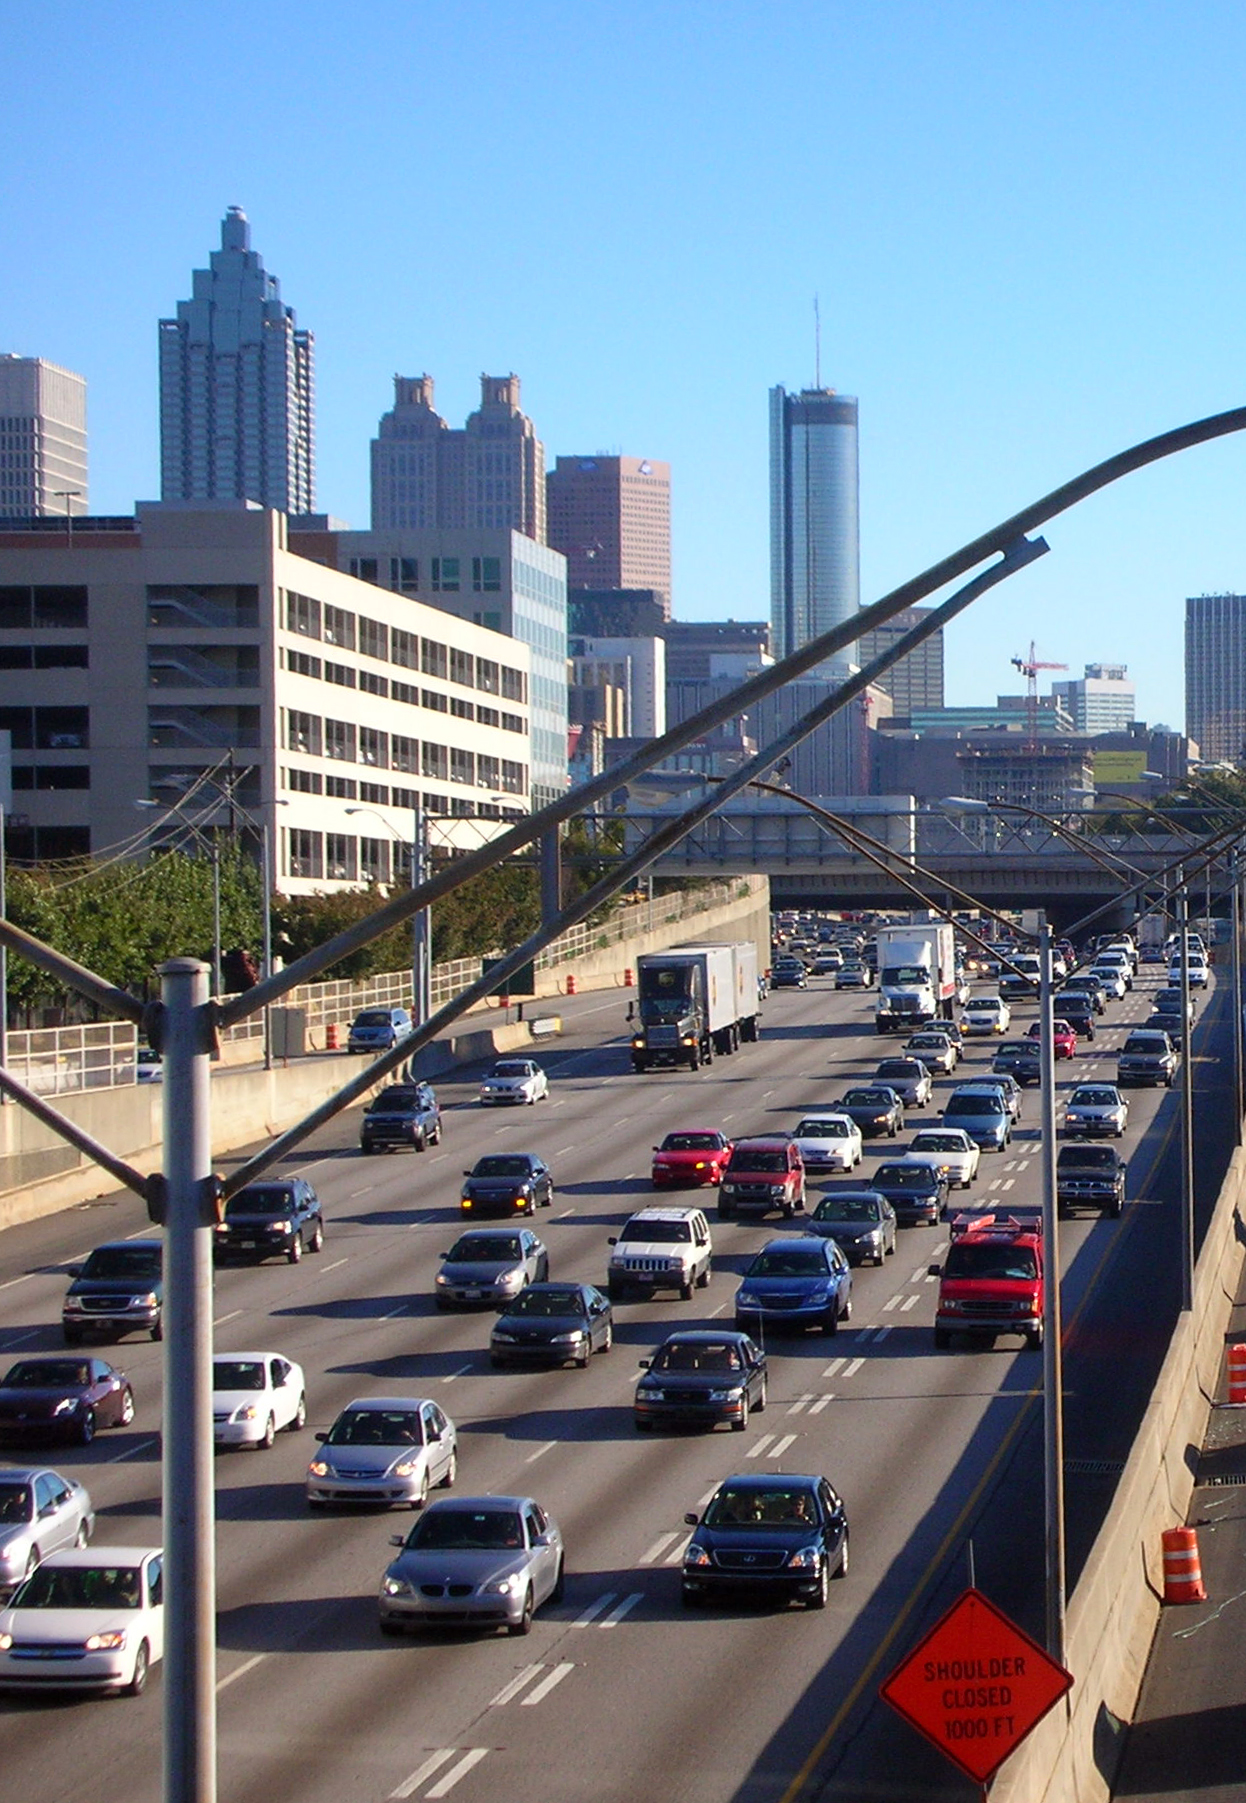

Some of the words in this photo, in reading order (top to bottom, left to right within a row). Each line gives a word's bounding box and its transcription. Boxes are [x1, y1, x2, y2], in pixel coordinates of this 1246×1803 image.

[924, 1657, 1025, 1682] SHOULDER
[942, 1687, 1012, 1709] CLOSED
[945, 1719, 988, 1740] 1000
[993, 1716, 1014, 1736] FT
